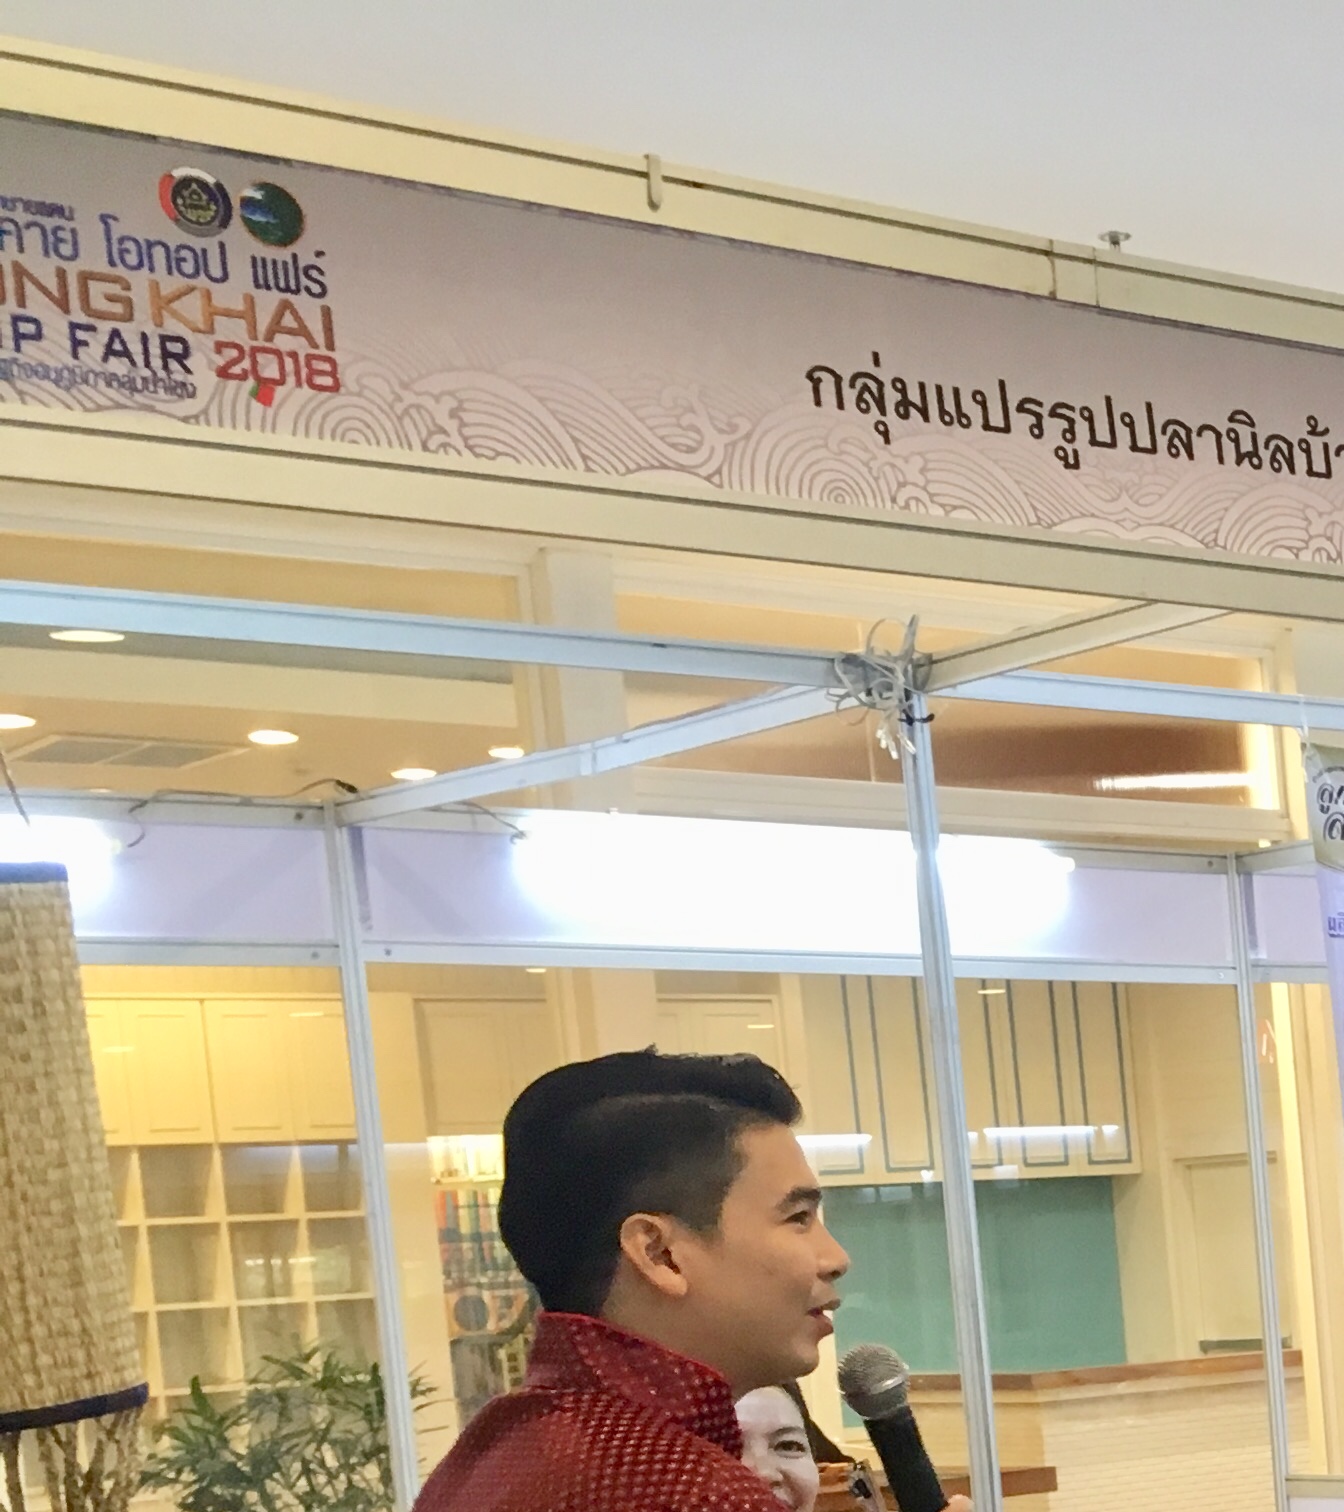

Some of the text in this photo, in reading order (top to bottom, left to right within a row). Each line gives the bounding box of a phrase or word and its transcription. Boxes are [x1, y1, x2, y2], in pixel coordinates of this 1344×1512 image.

[99, 213, 229, 284] โอทอป
[251, 250, 328, 299] แฟร์
[0, 259, 336, 351] NG KHAI
[68, 321, 194, 375] FAIR
[214, 340, 341, 393] 2018
